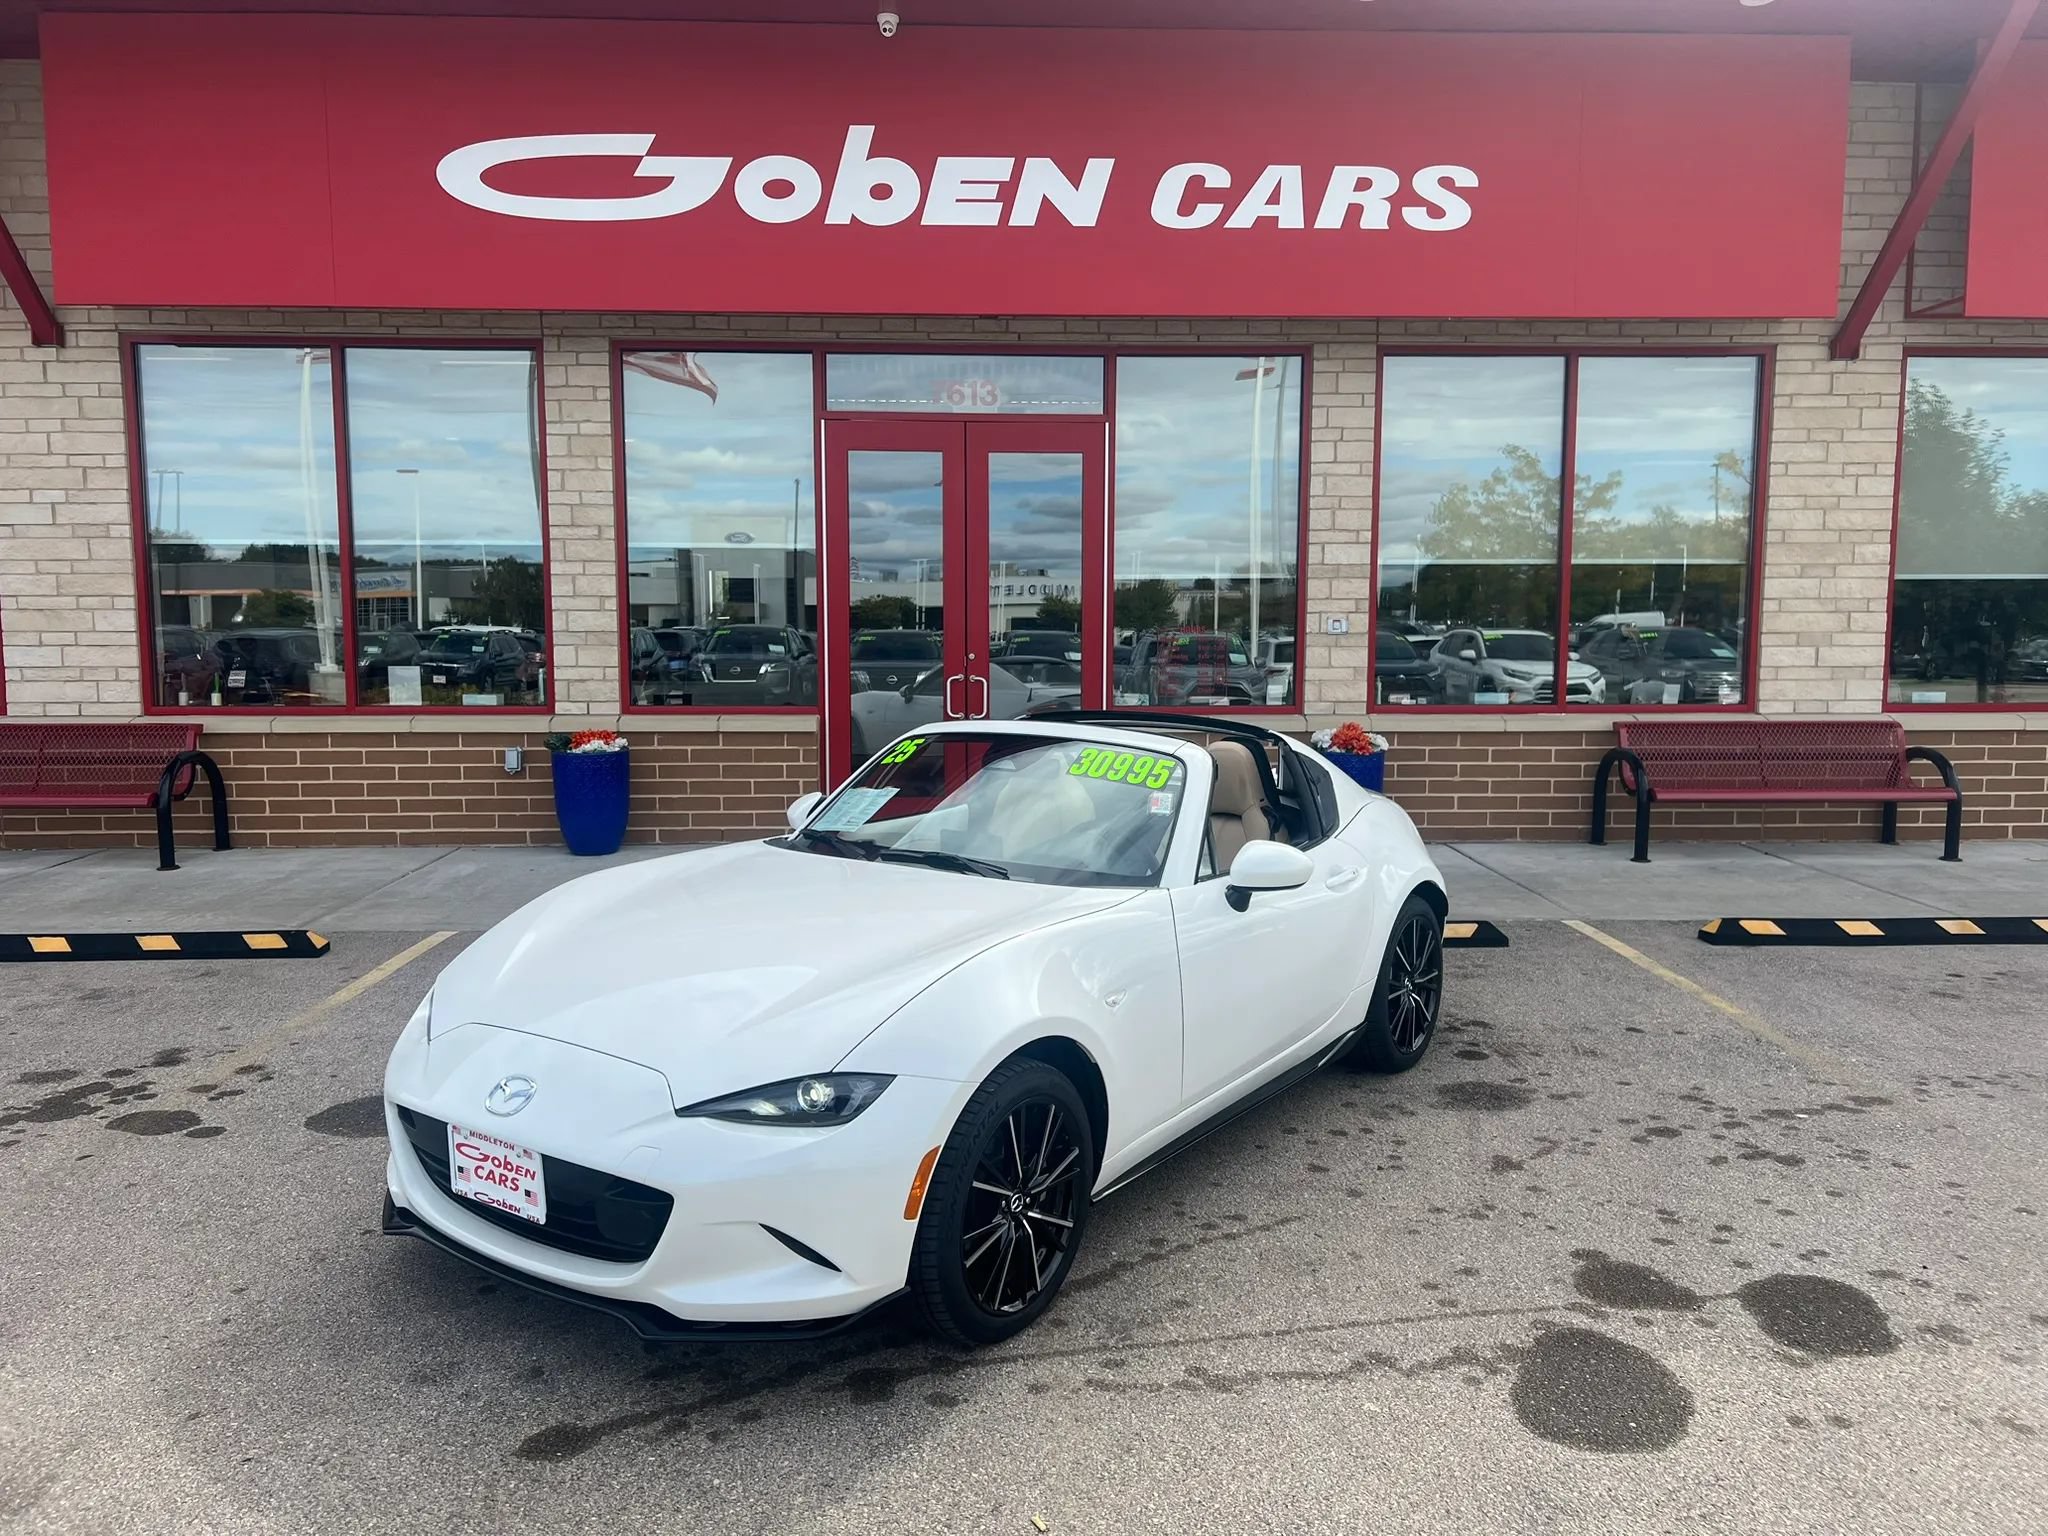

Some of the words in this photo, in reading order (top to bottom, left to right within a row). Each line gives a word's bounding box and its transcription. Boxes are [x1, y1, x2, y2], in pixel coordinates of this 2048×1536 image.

[1151, 163, 1478, 232] CARS
[882, 739, 925, 764] 25
[1070, 748, 1176, 789] 30995
[469, 1130, 515, 1151] MIDDLETON
[473, 1165, 520, 1192] CARS
[454, 1188, 468, 1197] USA
[527, 1214, 540, 1223] USA
